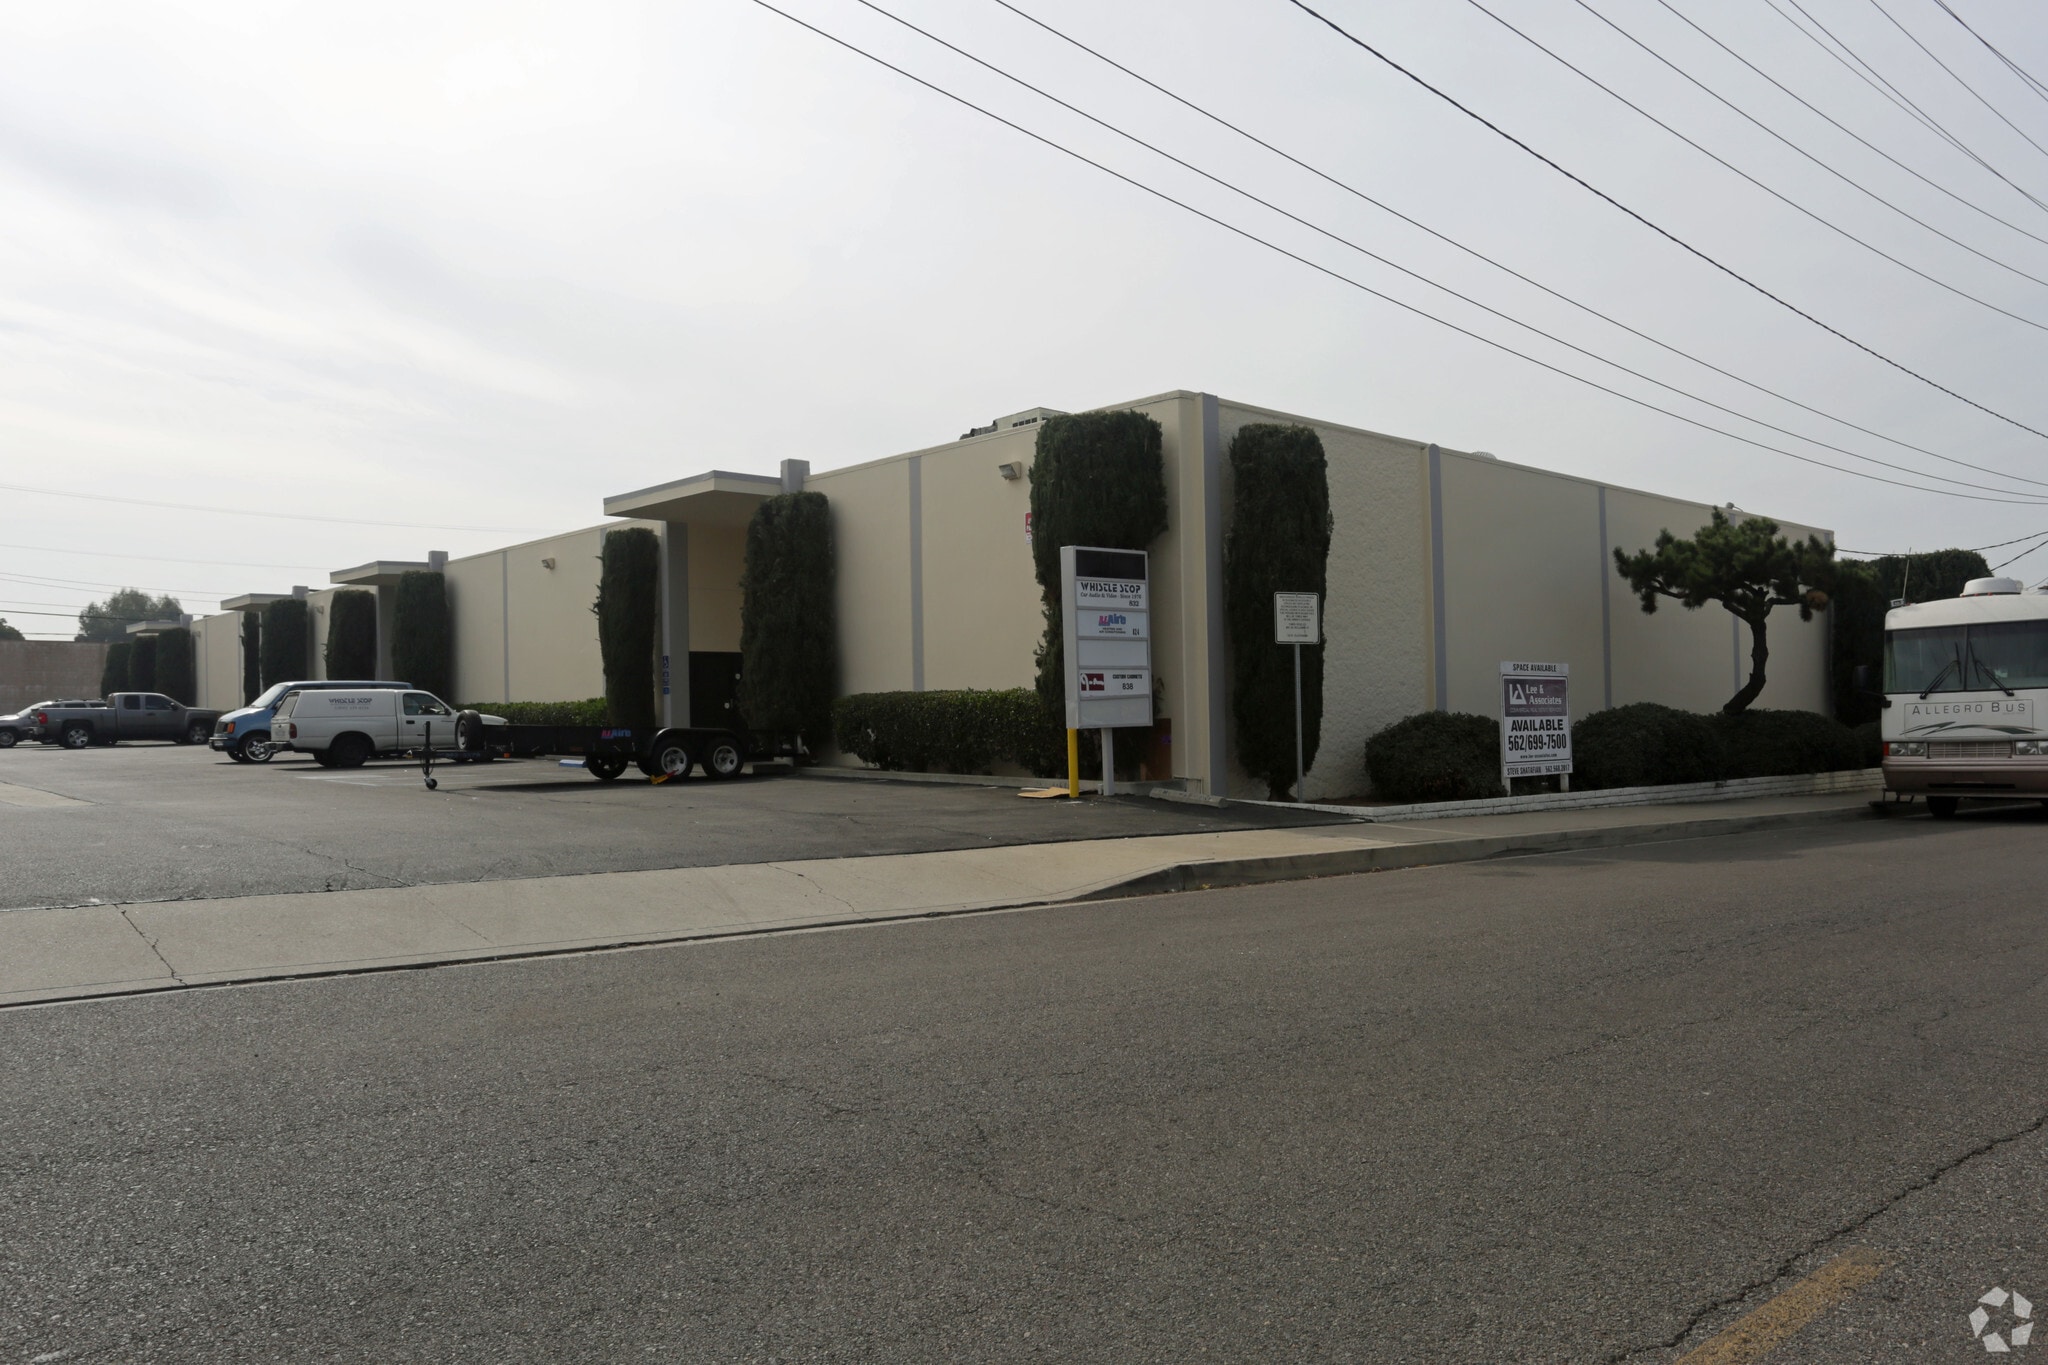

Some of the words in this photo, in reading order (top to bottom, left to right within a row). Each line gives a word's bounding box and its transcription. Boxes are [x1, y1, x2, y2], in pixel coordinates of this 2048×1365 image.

[1081, 582, 1117, 592] WHISTLE
[1120, 584, 1141, 594] STOP
[1513, 664, 1529, 672] SPACE
[1526, 684, 1538, 694] Lee
[1540, 684, 1544, 694] &
[1529, 695, 1562, 704] Associates
[1912, 704, 1983, 715] ALLEGRO
[1991, 702, 2026, 712] BUS
[1511, 719, 1564, 732] AVAILABLE
[1508, 734, 1567, 752] 562/699-7500
